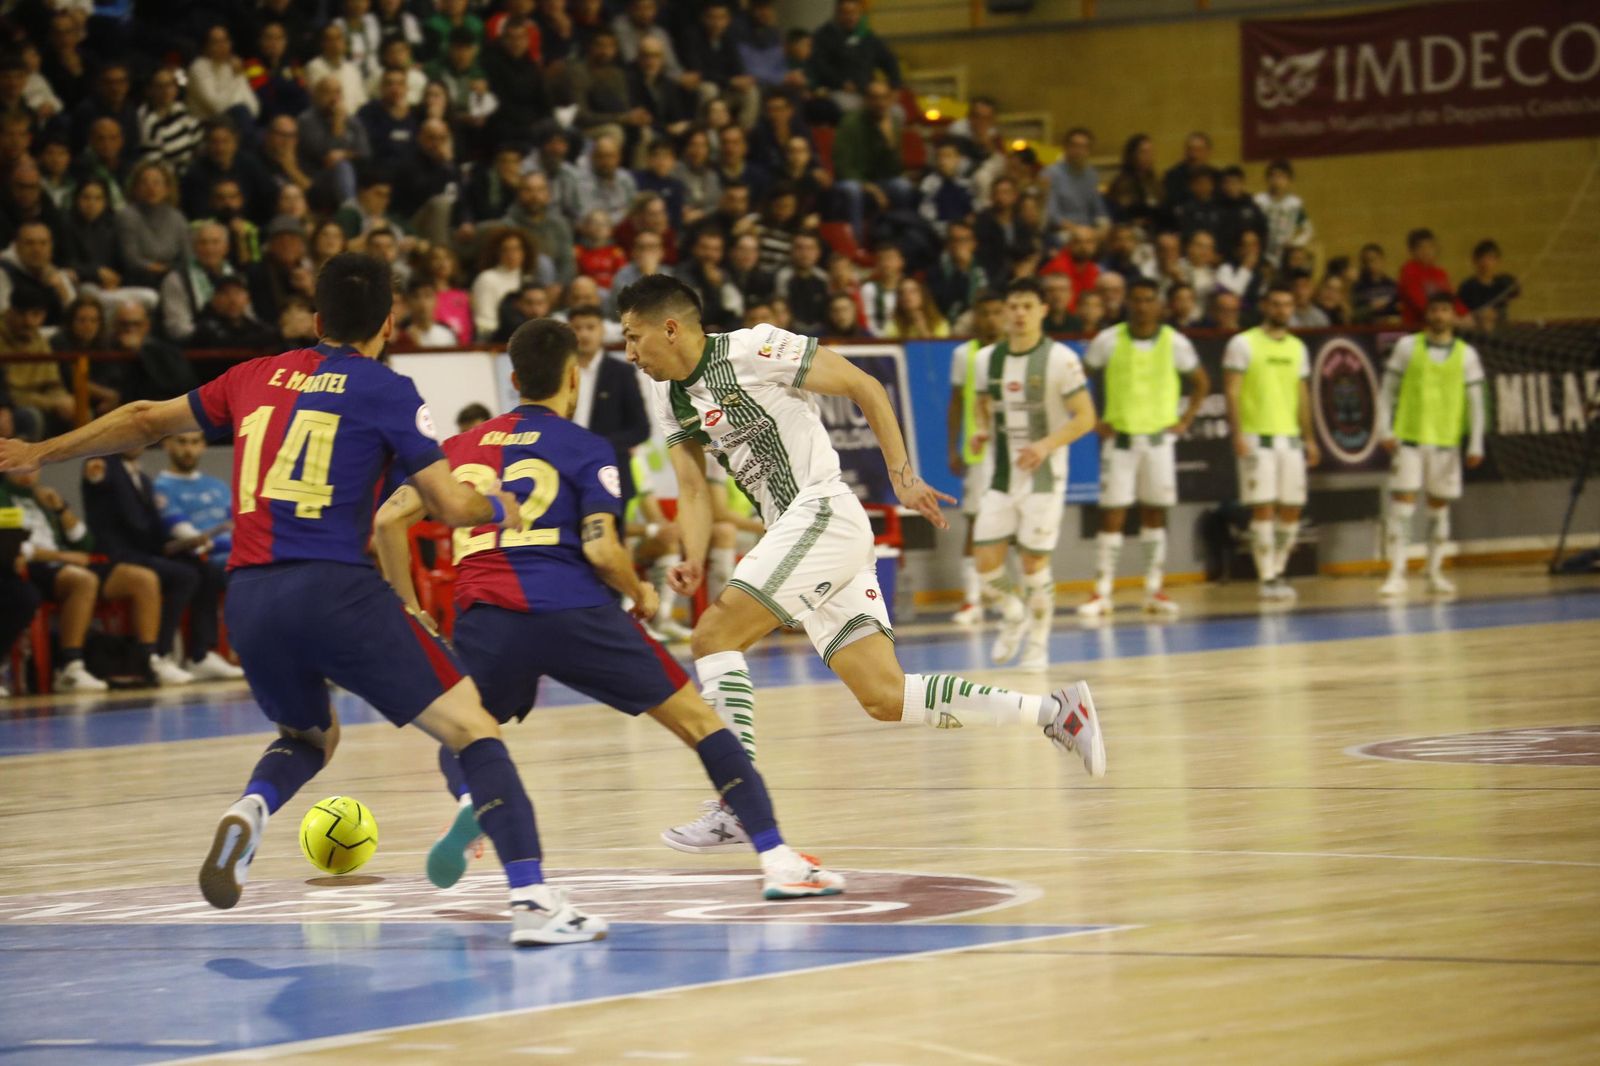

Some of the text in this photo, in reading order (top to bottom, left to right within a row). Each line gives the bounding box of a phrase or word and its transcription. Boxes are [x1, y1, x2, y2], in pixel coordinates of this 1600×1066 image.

[1333, 22, 1600, 102] IMDECO
[284, 370, 348, 394] MARTEL
[238, 405, 342, 520] 14
[450, 457, 560, 567] 22
